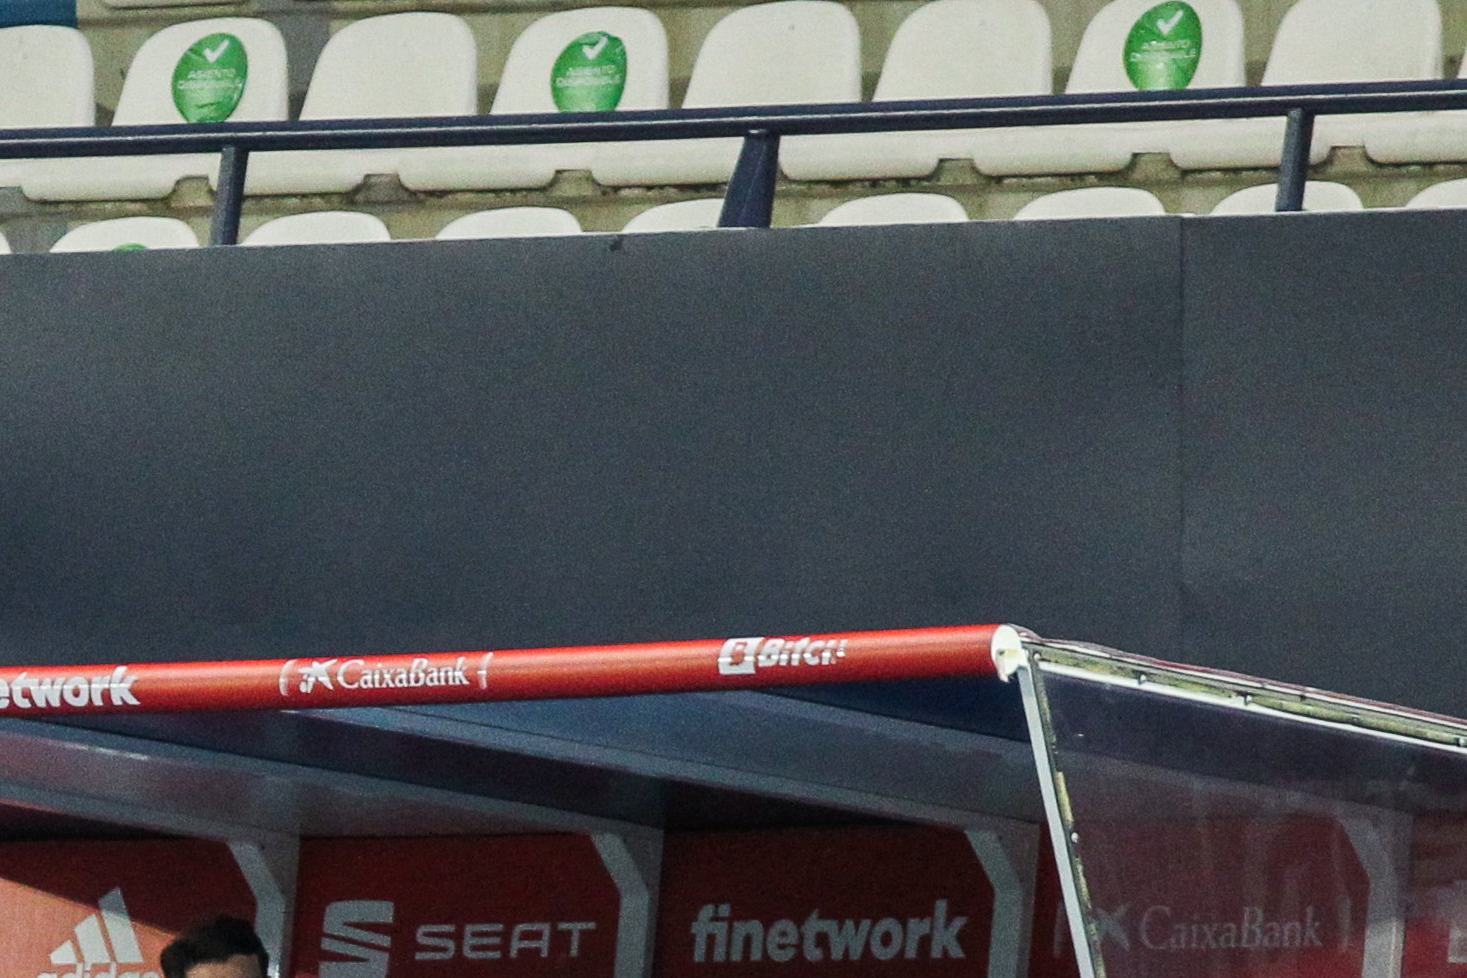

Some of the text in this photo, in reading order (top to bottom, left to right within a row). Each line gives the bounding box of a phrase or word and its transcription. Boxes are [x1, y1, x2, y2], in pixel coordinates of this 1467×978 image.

[337, 656, 470, 690] CaixaBank
[414, 920, 597, 960] SEAT
[691, 898, 968, 963] finetwork
[1139, 904, 1324, 951] CaixaBank
